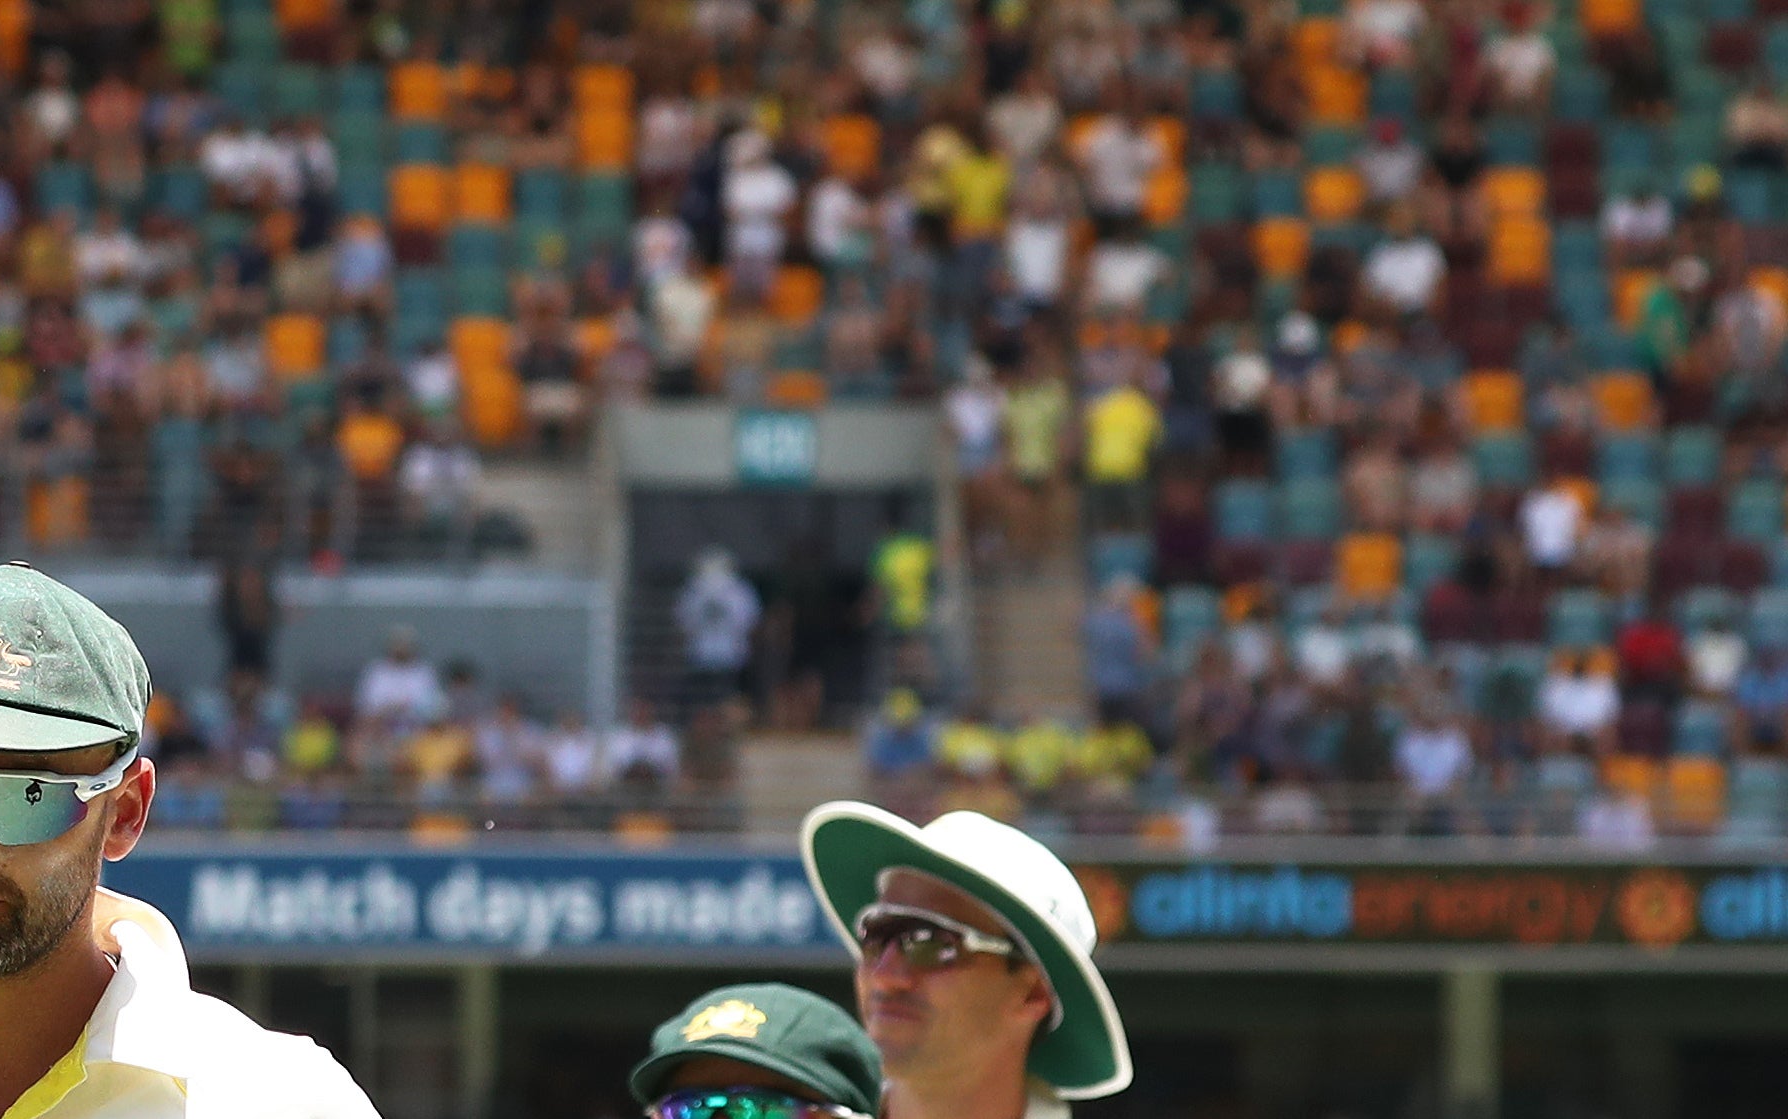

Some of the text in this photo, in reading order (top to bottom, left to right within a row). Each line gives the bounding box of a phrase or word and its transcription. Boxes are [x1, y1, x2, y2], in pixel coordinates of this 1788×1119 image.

[190, 862, 812, 956] Match days made
[1129, 862, 1353, 938] alinta
